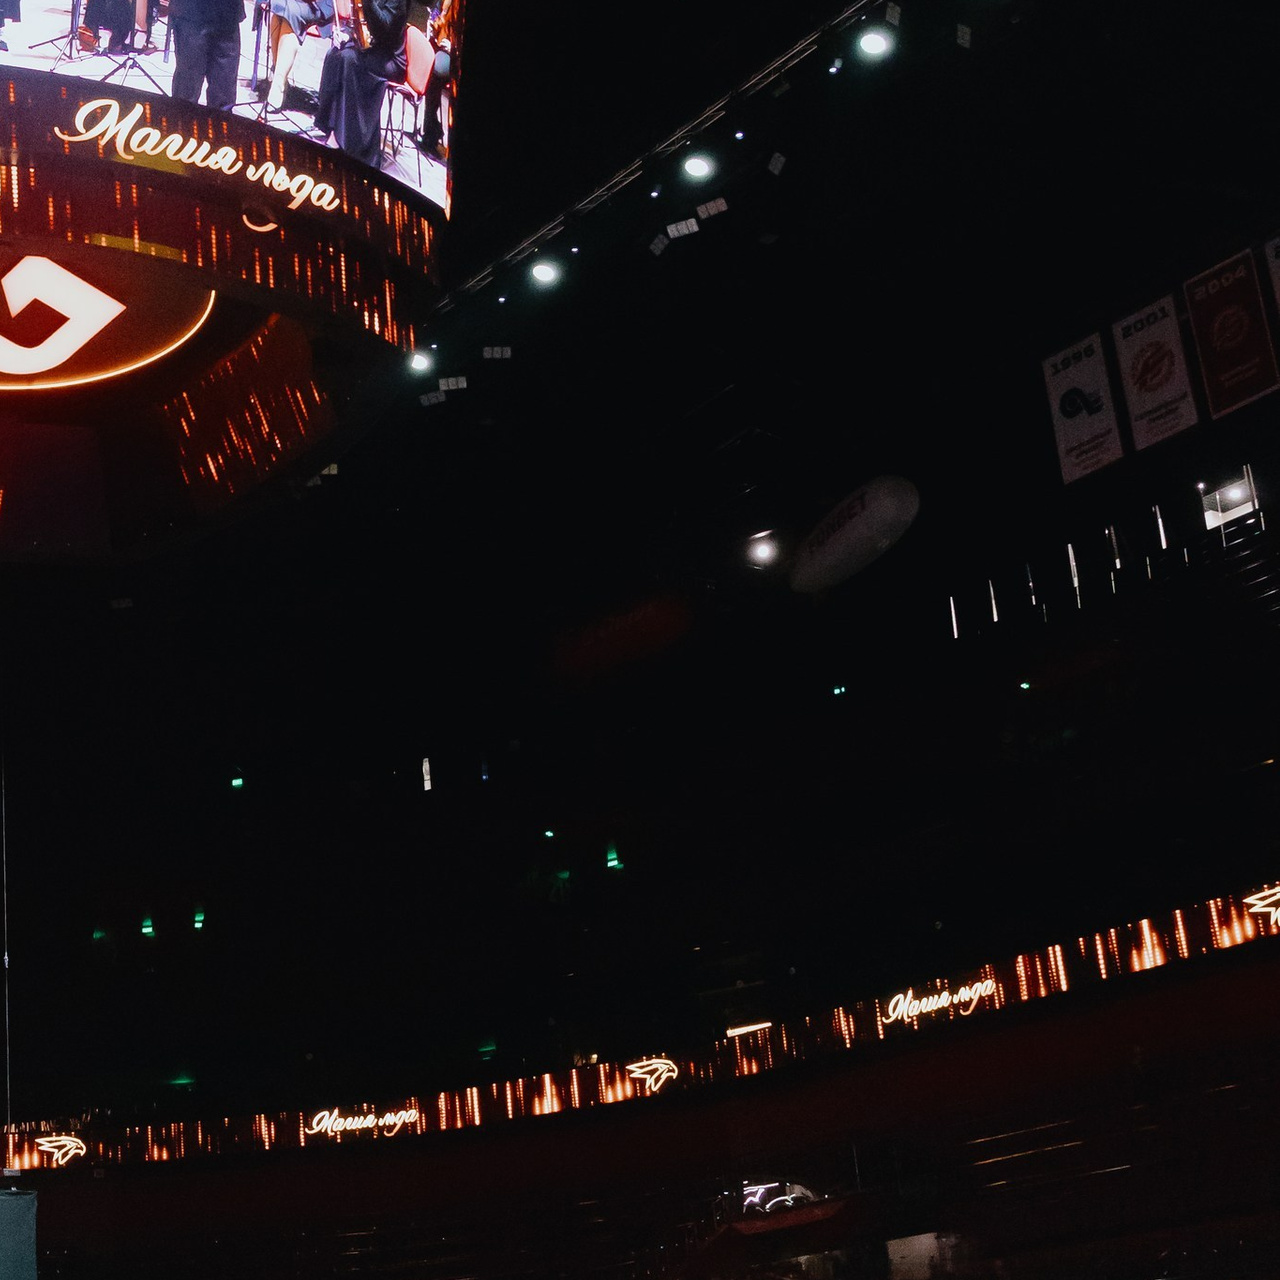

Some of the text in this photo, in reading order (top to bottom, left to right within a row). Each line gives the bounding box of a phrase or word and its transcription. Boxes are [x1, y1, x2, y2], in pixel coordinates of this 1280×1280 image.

[54, 98, 341, 232] Магия льда
[1122, 306, 1169, 340] 2001
[882, 979, 996, 1023] Магия льда
[305, 1108, 419, 1137] Магия льда
